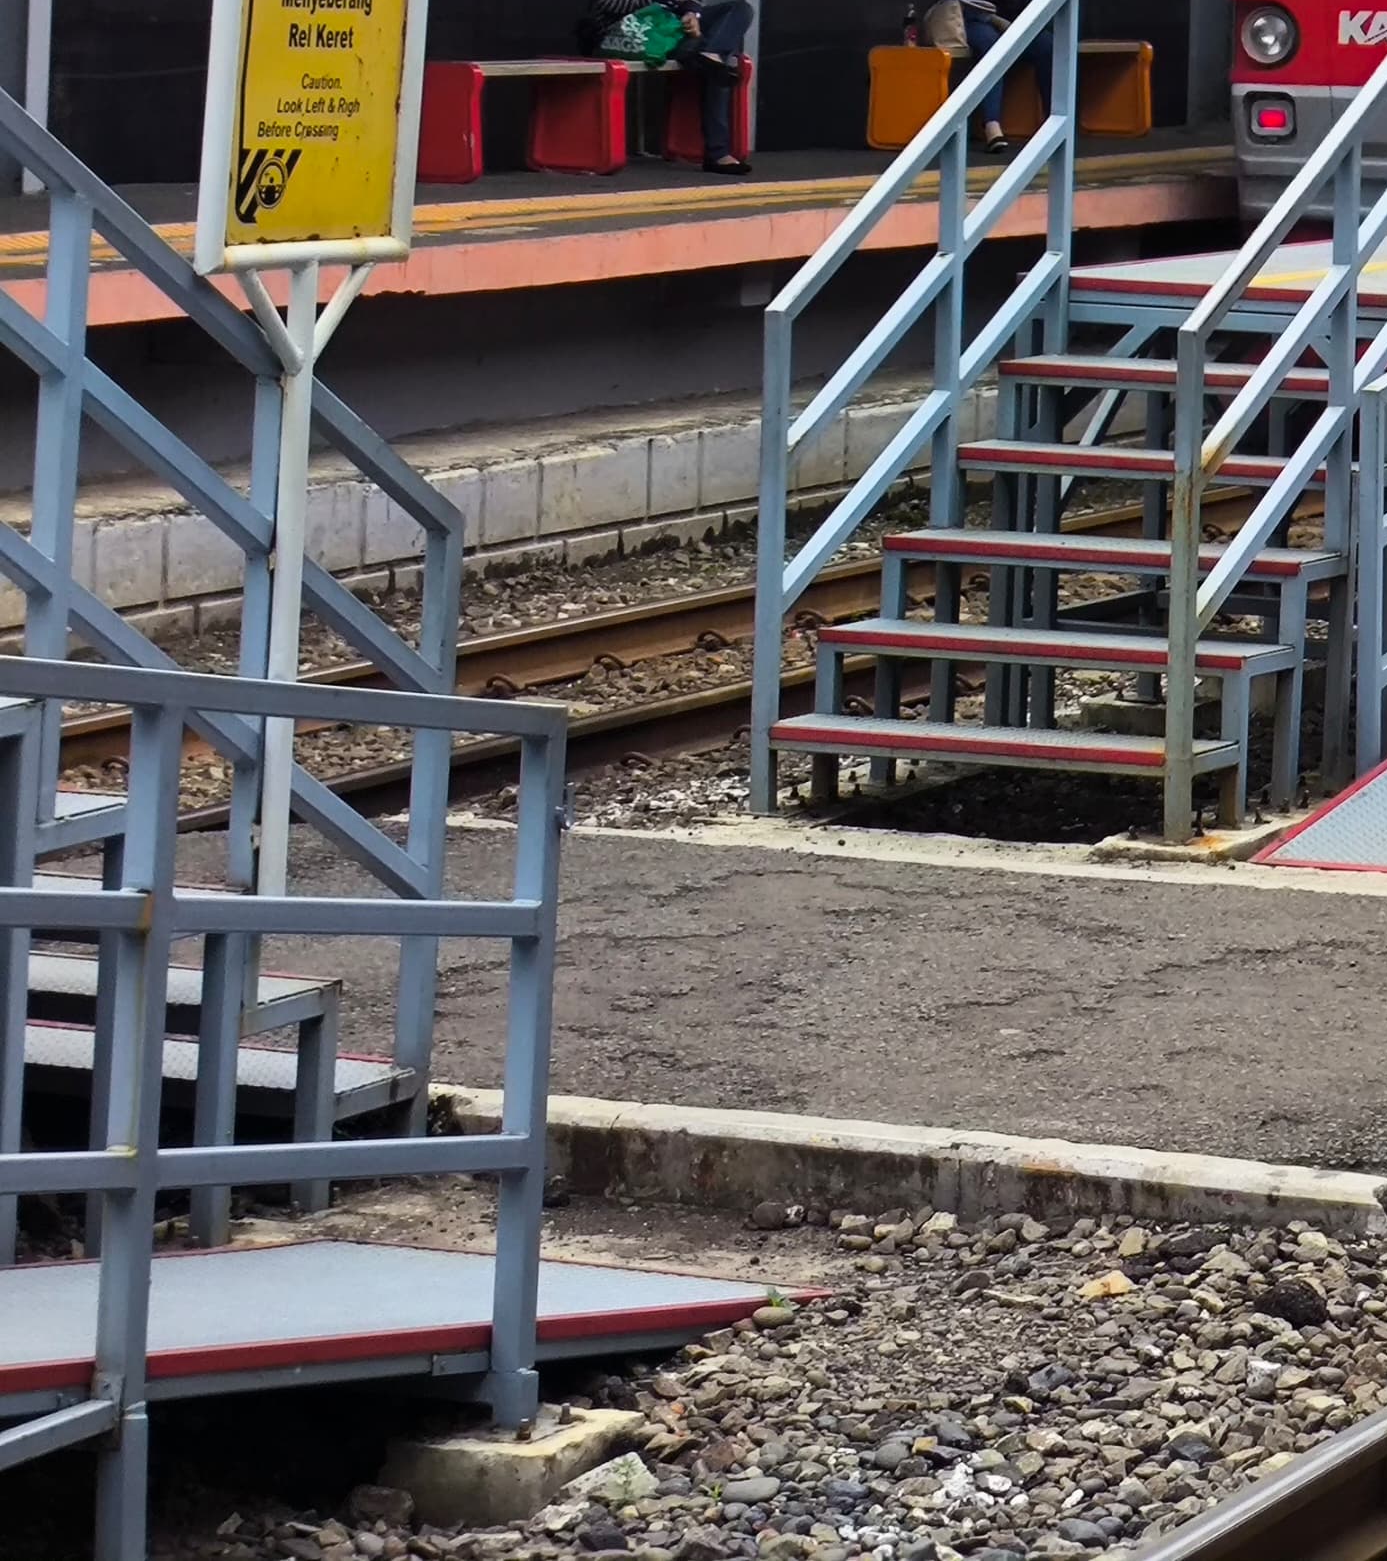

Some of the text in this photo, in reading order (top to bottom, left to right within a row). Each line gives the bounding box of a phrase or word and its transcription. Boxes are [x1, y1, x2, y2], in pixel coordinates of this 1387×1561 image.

[288, 22, 354, 50] Rel Keret
[276, 96, 302, 115] Look
[304, 96, 326, 115] Left
[327, 97, 336, 115] &
[257, 120, 339, 142] Before Crossing
